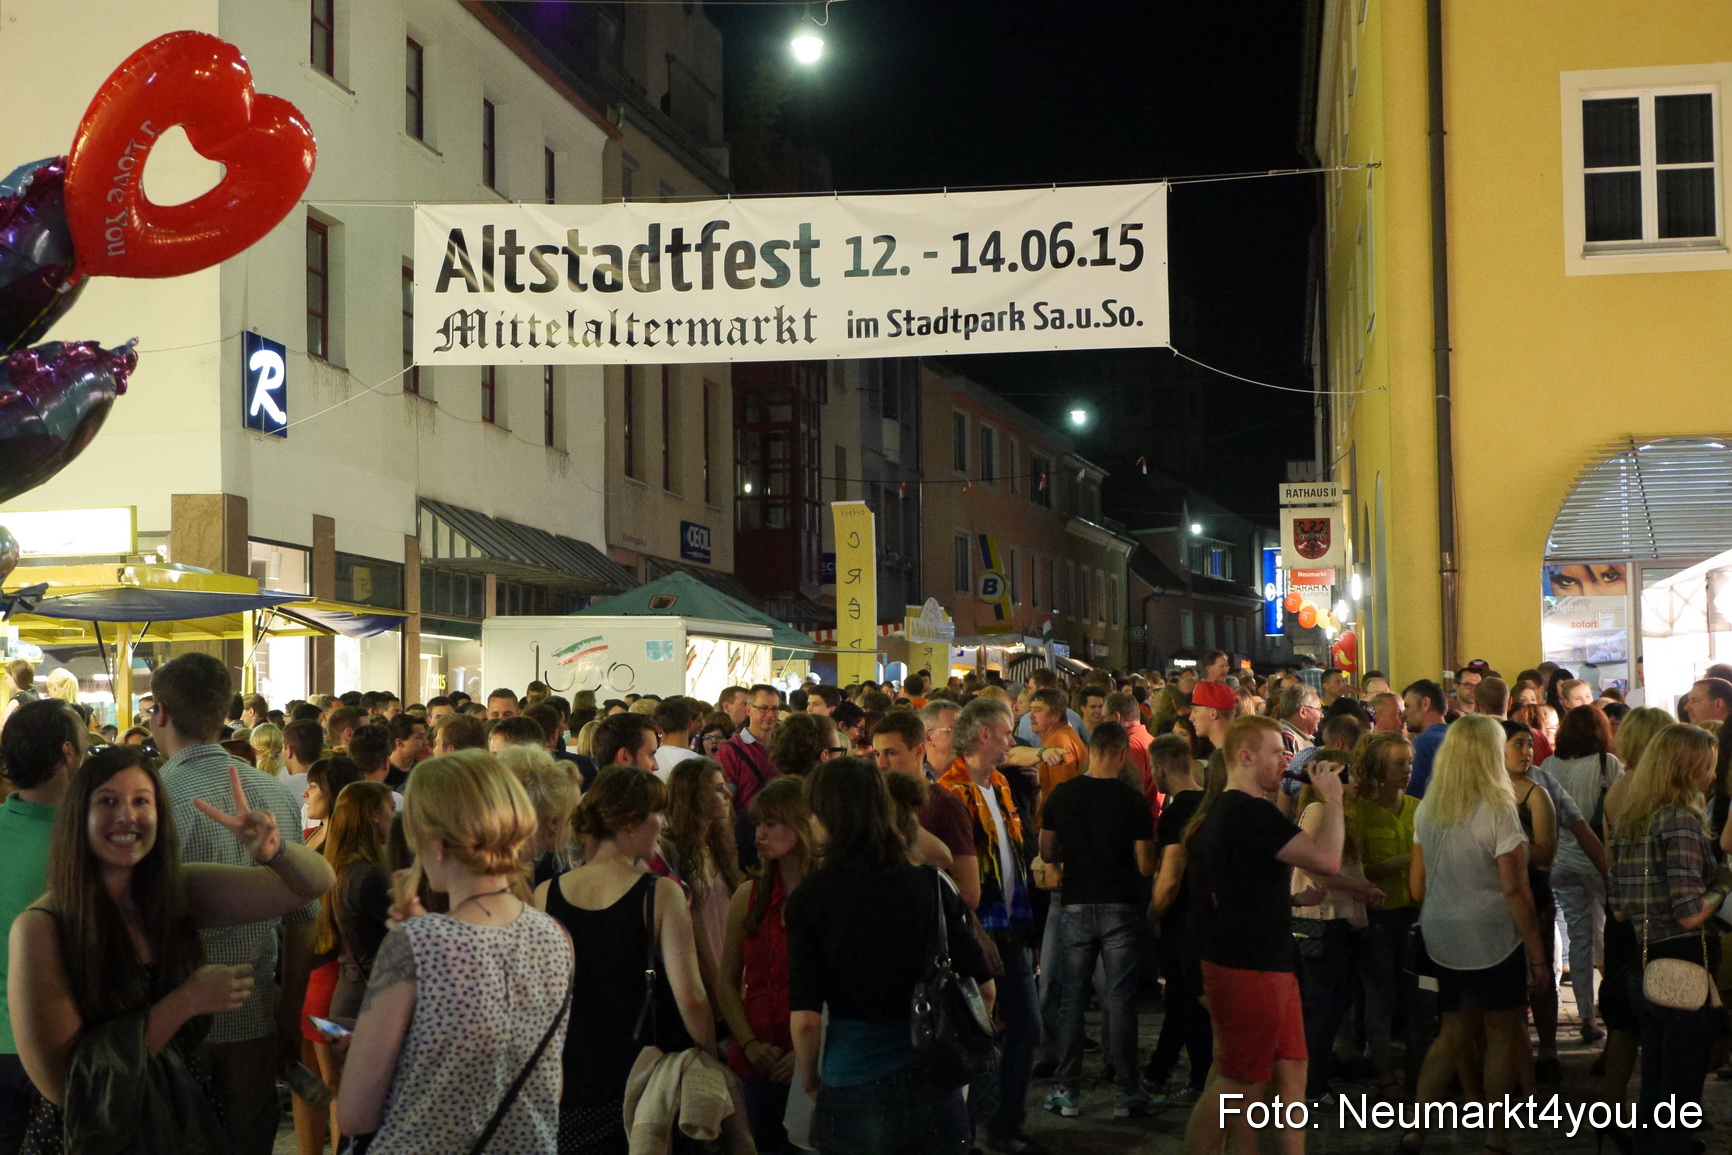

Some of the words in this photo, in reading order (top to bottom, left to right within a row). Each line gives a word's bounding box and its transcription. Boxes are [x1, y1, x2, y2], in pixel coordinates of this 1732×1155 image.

[106, 138, 147, 203] Love
[105, 206, 128, 257] You
[435, 219, 821, 294] Altstadtfest
[843, 234, 911, 278] 12.
[923, 251, 938, 259] -
[951, 221, 1144, 275] 14.06.15
[433, 304, 818, 354] Mittelaltermarkt
[847, 309, 879, 339] im
[886, 301, 1026, 341] Stadtpark
[249, 349, 287, 425] R
[1285, 487, 1329, 499] RATHAUS
[981, 578, 999, 596] B
[1289, 584, 1320, 592] SARAH
[1551, 603, 1586, 614] Digitale
